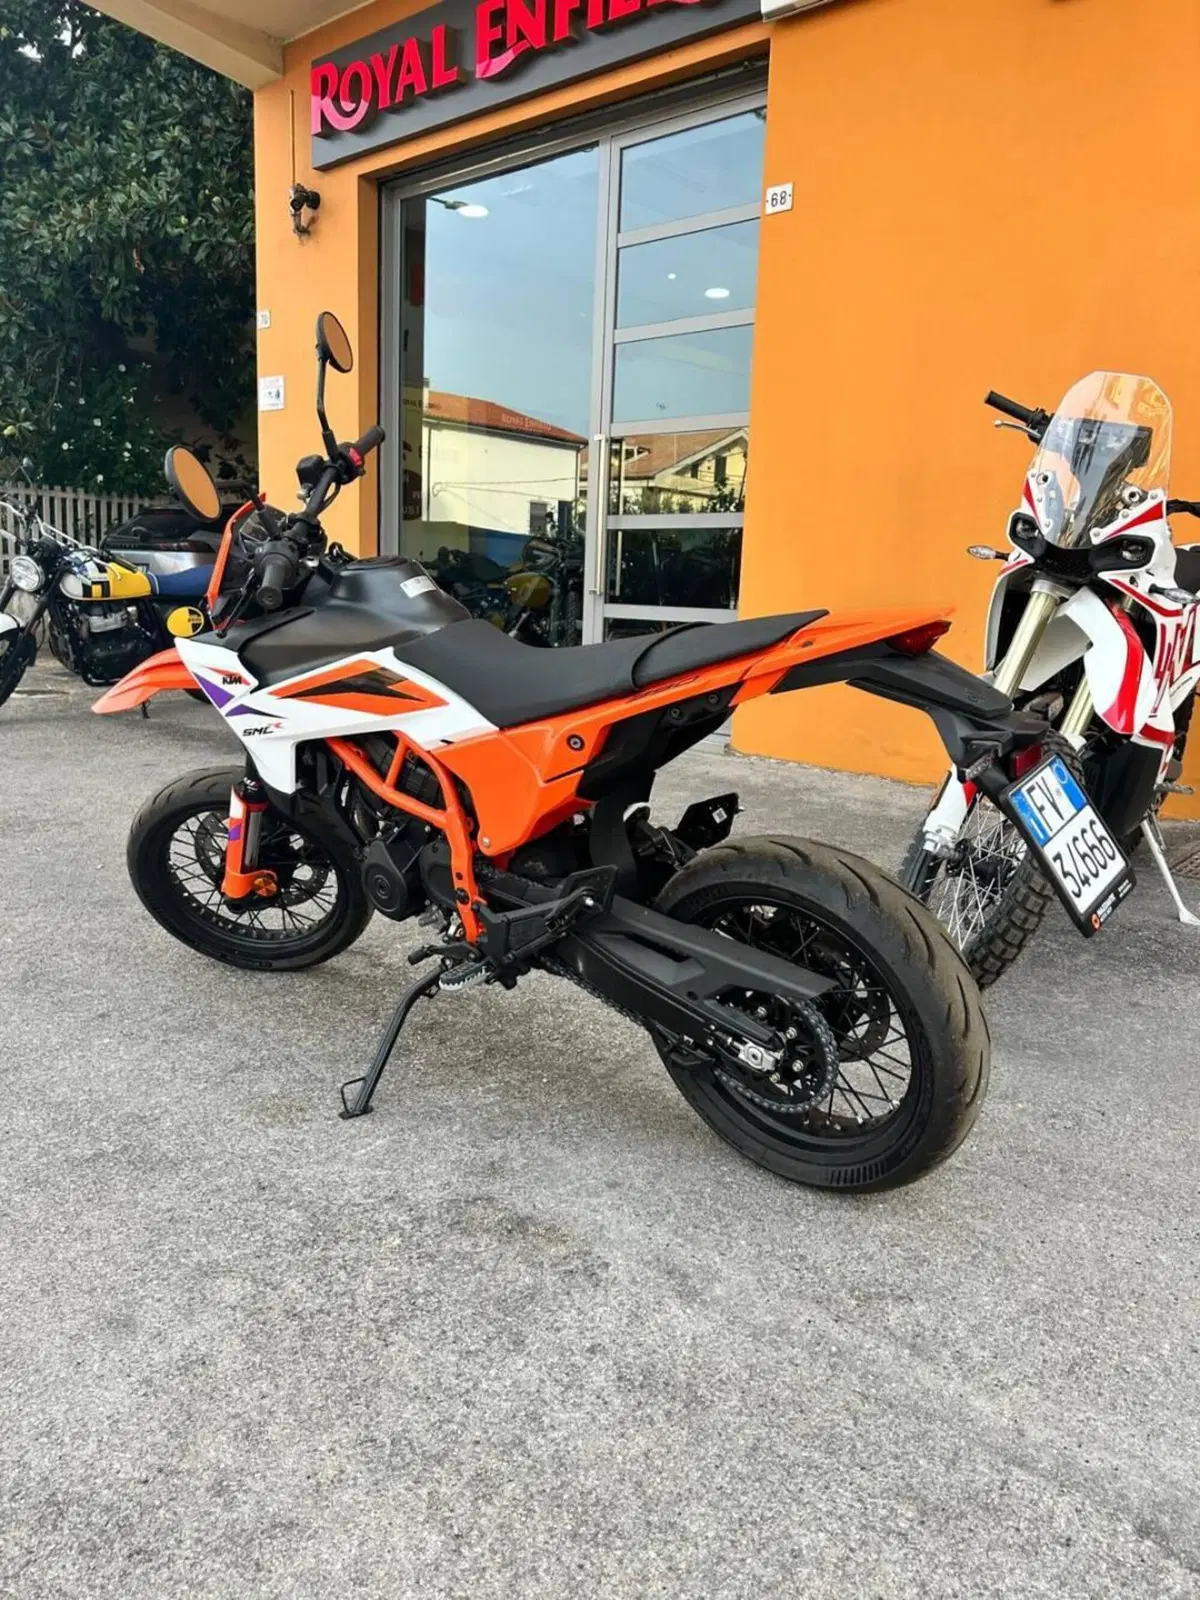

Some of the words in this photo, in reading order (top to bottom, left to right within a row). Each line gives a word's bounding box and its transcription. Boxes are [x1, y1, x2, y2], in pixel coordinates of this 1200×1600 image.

[311, 24, 458, 136] ROYAL
[770, 190, 787, 208] 68
[222, 675, 242, 685] KTM
[1052, 819, 1116, 898] 34666
